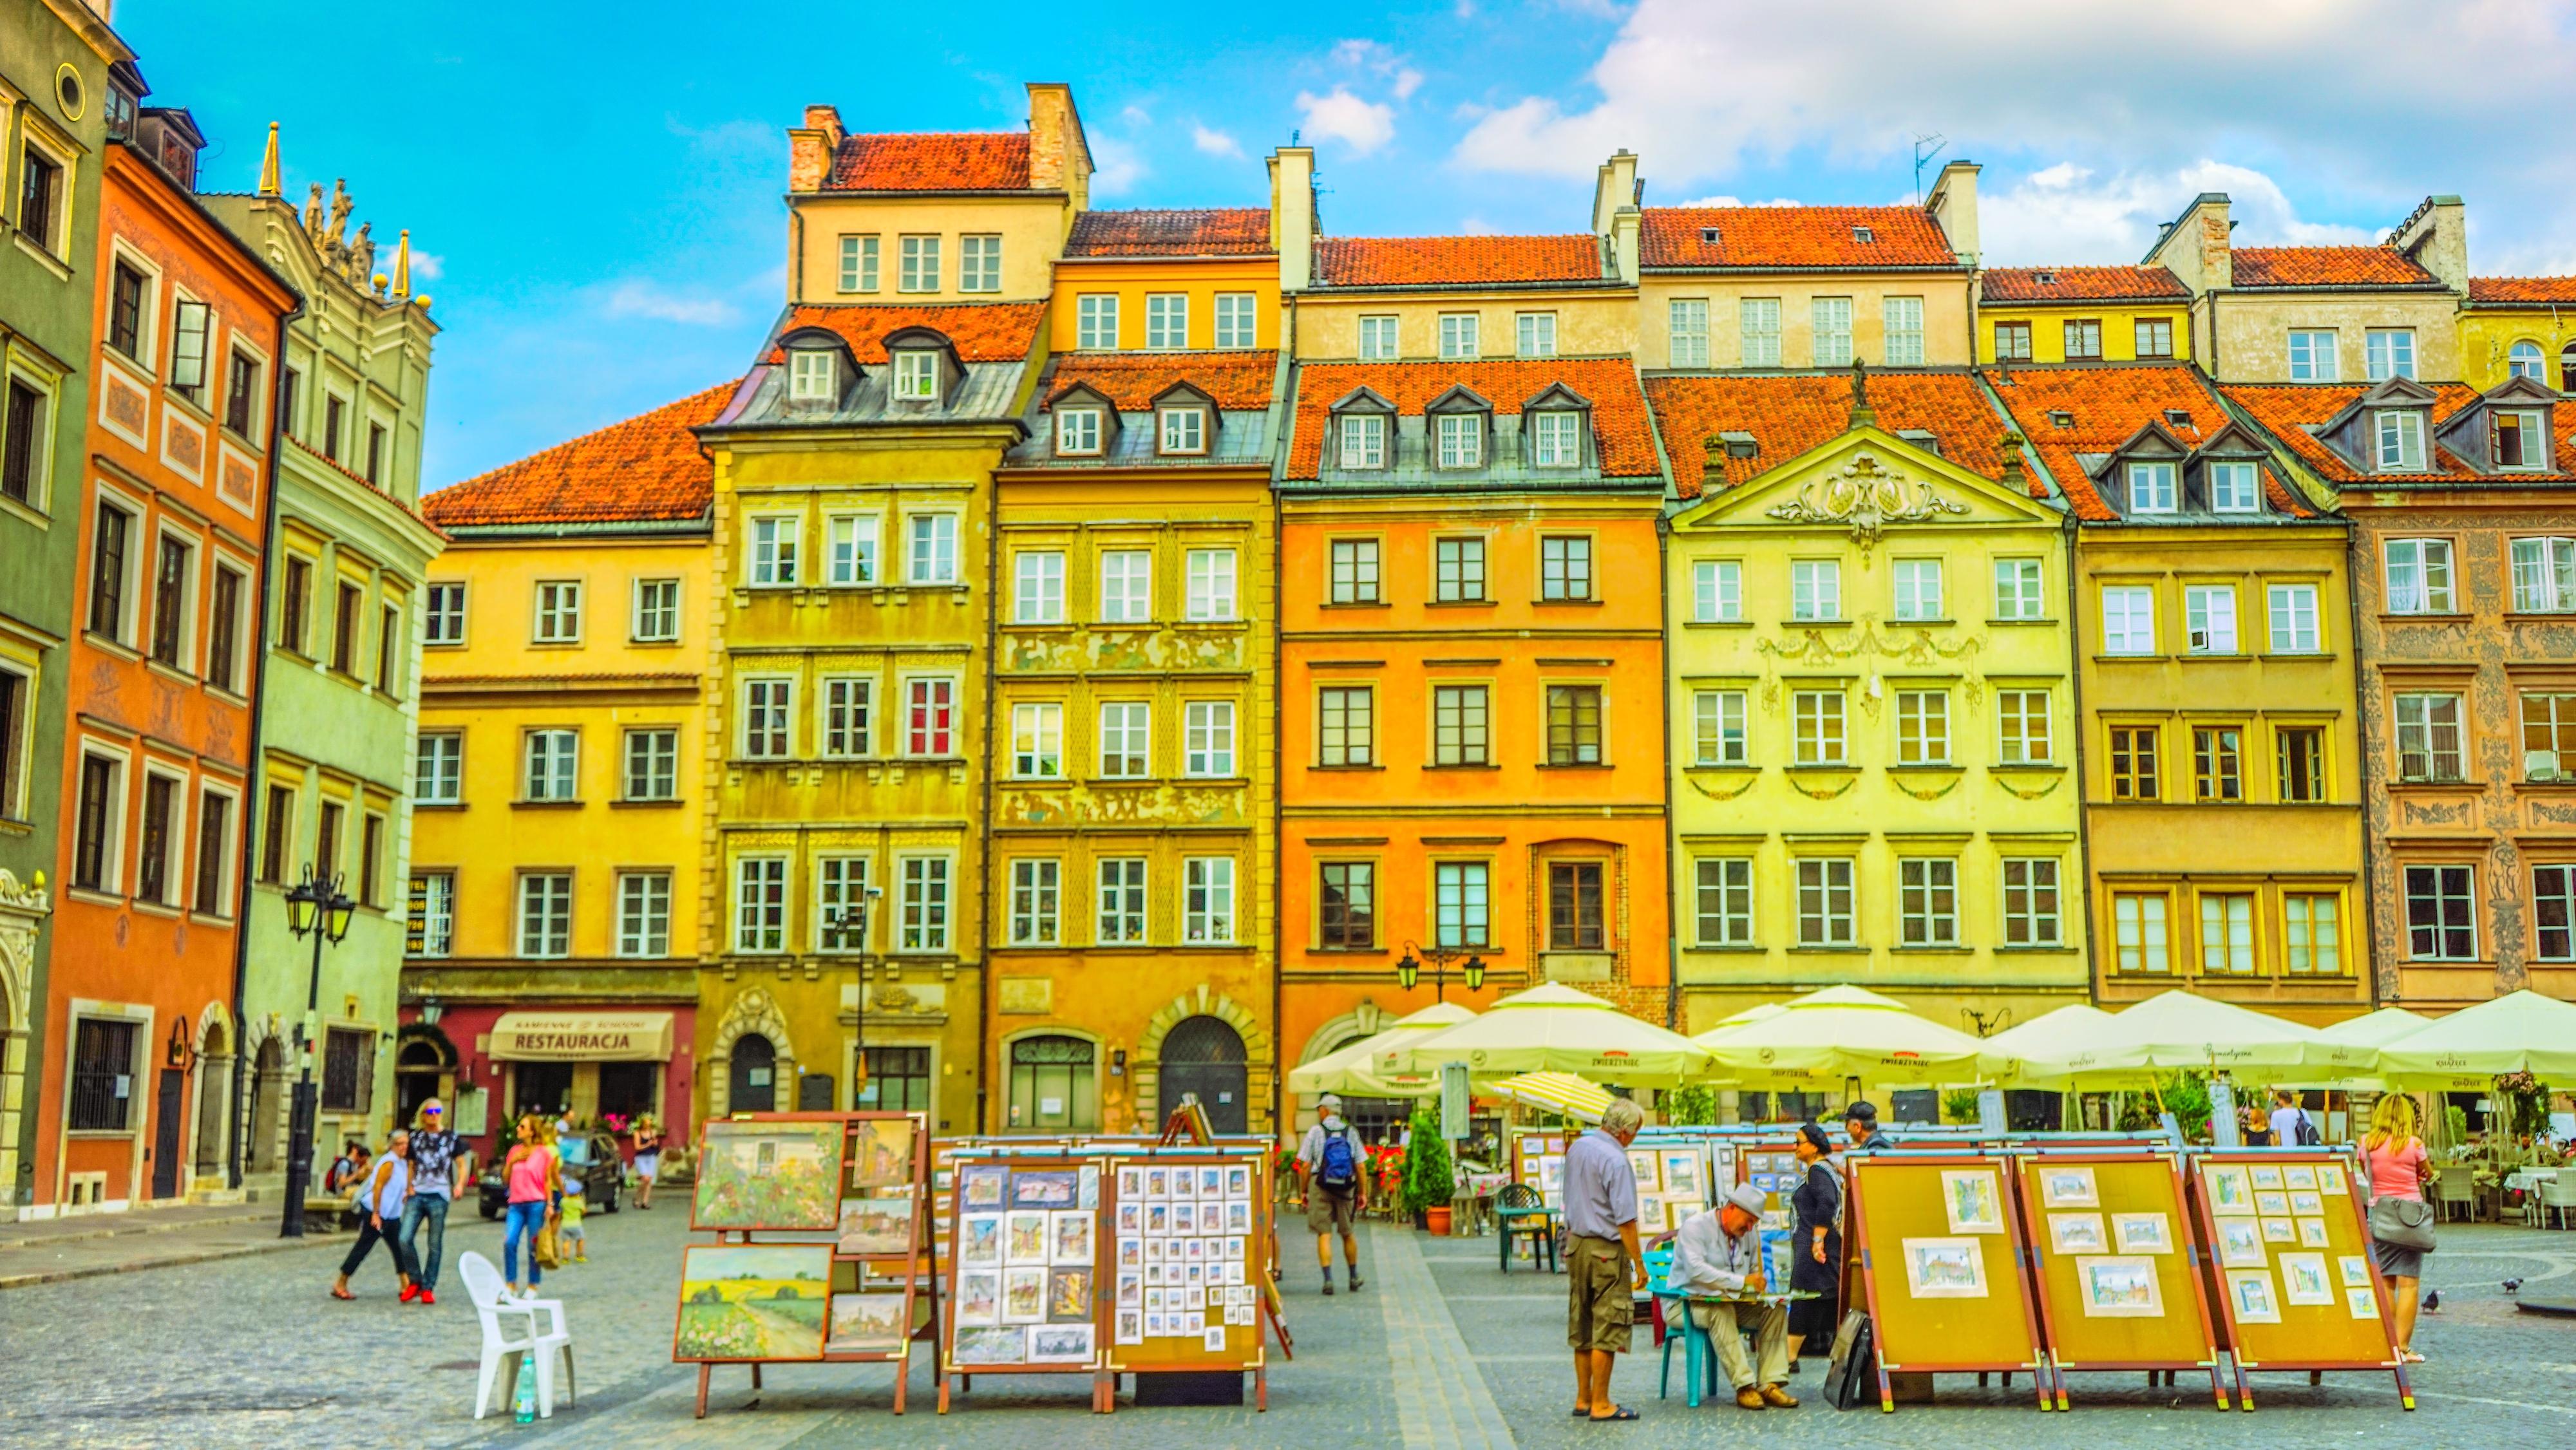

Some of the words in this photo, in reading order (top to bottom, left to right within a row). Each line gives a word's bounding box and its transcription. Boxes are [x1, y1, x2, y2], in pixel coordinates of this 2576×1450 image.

[515, 1033, 629, 1049] RESTAURACJA
[1592, 1058, 1639, 1067] ZWIERZYNIEC
[1880, 1058, 1930, 1068] ZWIERZYNIEC
